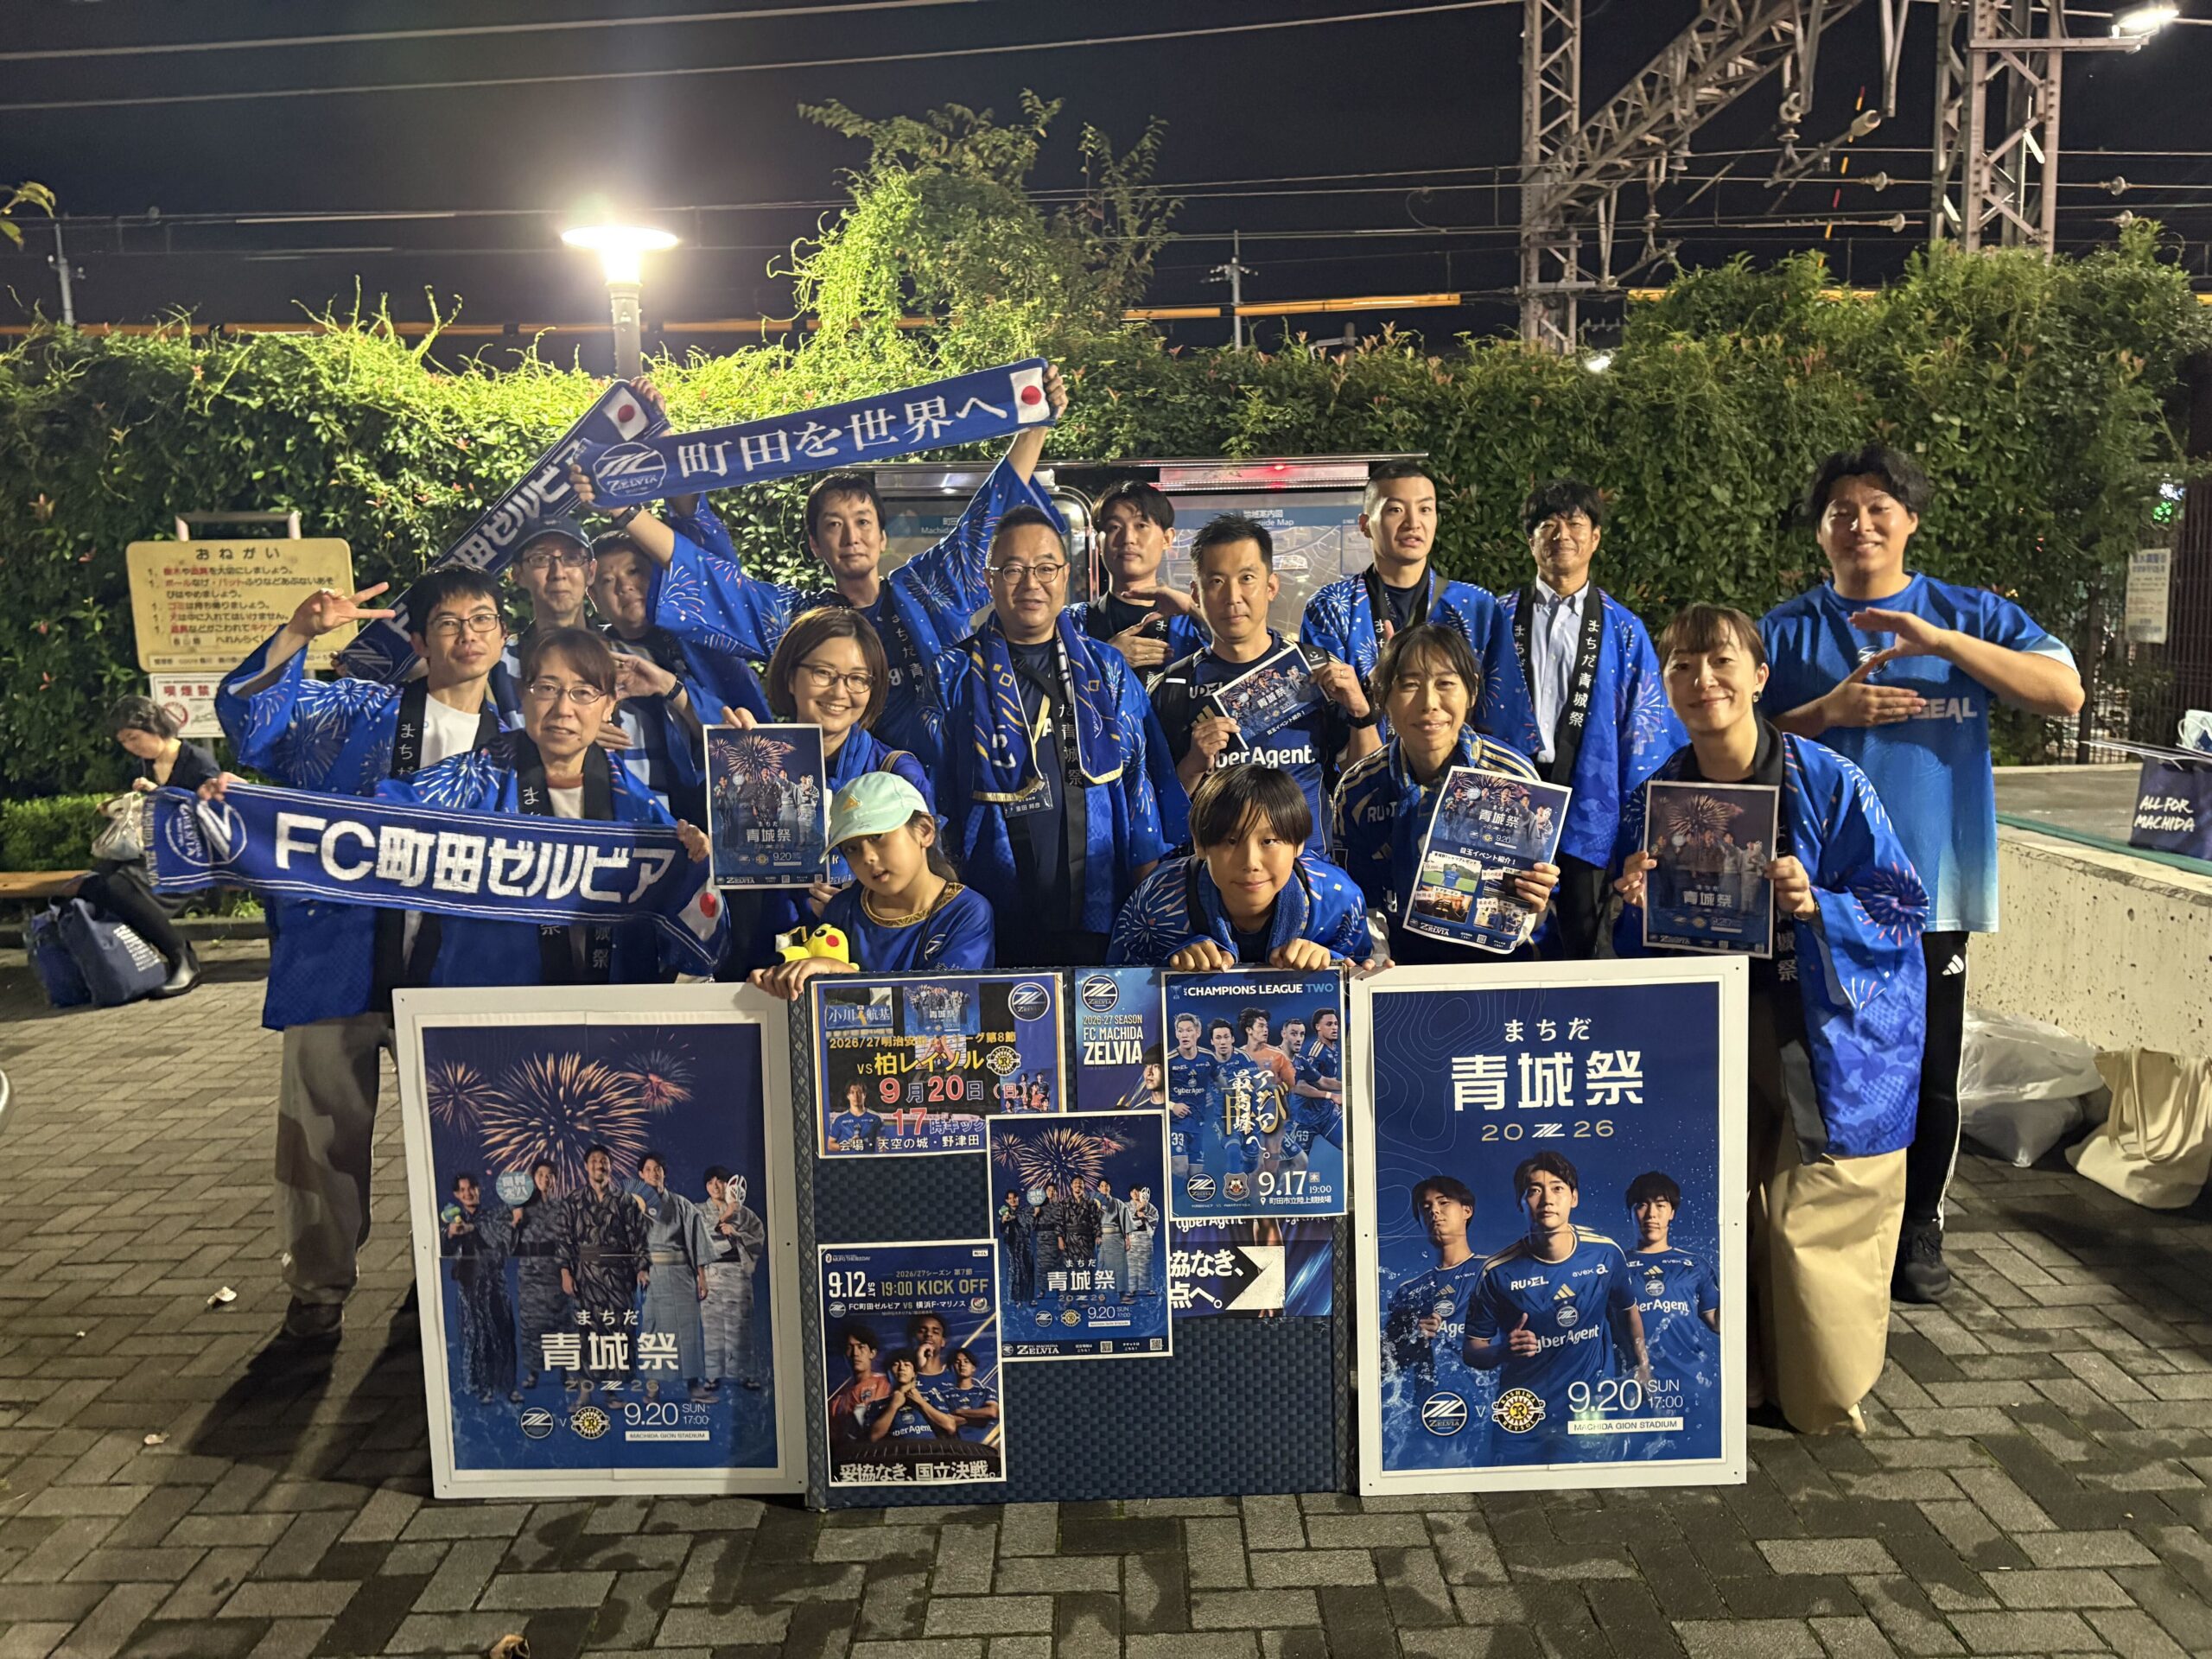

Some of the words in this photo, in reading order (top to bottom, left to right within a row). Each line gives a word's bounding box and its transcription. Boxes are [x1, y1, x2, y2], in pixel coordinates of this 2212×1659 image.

[677, 395, 1008, 479] 町田を世界へ
[1243, 509, 1283, 518] 地域案内図
[195, 547, 280, 561] おねがい
[166, 590, 242, 599] びはやめましょう。
[168, 601, 270, 610] ゴミは持ち帰りましょう。
[1568, 620, 1600, 728] まちだ青城祭
[163, 684, 218, 697] 喫煙禁
[2139, 794, 2160, 810] ALL
[2161, 797, 2194, 814] FOR
[1478, 809, 1520, 830] 青城祭
[2133, 813, 2196, 833] MACHIDA
[746, 828, 792, 843] 青城祭
[1496, 834, 1512, 844] 9.20
[276, 810, 676, 904] FC町田ゼルビア
[772, 851, 792, 862] 9.20
[1459, 846, 1516, 866] 目玉イベント紹介！
[1682, 890, 1732, 908] 青城祭
[1420, 922, 1450, 936] ZELVIA
[1188, 983, 1257, 997] CHAMPIONS
[1259, 983, 1303, 995] LEAGUE
[1306, 982, 1334, 993] TWO
[828, 1009, 855, 1022] 小川
[866, 1007, 892, 1021] 航基
[1083, 1014, 1113, 1026] 2026-27
[1115, 1014, 1143, 1025] SEASON
[1084, 1027, 1096, 1040] FC
[1099, 1026, 1144, 1040] MACHIDA
[1503, 1016, 1592, 1042] まちだ
[1083, 1040, 1143, 1065] ZELVIA
[874, 1049, 985, 1077] 柏レイソル
[879, 1073, 985, 1104] 9月20日
[1451, 1049, 1643, 1112] 青城祭
[1481, 1123, 1524, 1141] 20
[1573, 1119, 1615, 1138] 26
[839, 1134, 981, 1153] 会場・天空の城・野津田
[1257, 1170, 1307, 1197] 9.17
[1310, 1173, 1319, 1182] 木
[1309, 1185, 1332, 1195] 19:00
[1268, 1195, 1332, 1205] 町田市立陸上競技場
[1065, 1258, 1096, 1268] まちだ
[828, 1271, 867, 1299] 9.12
[868, 1281, 876, 1298] SAT
[881, 1281, 913, 1297] 19:00
[917, 1279, 955, 1296] KICK
[958, 1278, 989, 1294] OFF
[1046, 1269, 1116, 1292] 青城祭
[849, 1302, 900, 1311] FC町田ゼルビア
[903, 1301, 913, 1310] VS
[916, 1299, 966, 1309] 横浜F・マリノス
[1087, 1306, 1116, 1319] 9.20
[576, 1308, 639, 1326] まちだ
[540, 1332, 679, 1372] 青城祭
[1017, 1344, 1060, 1355] ZELVIA
[1567, 1379, 1643, 1413] 9.20
[1648, 1379, 1681, 1392] SUN
[1648, 1395, 1684, 1409] 17:00
[624, 1402, 679, 1426] 9.20
[682, 1403, 707, 1414] SUN
[683, 1415, 709, 1425] 17:00
[1573, 1422, 1614, 1432] MACHIDA
[1616, 1421, 1638, 1430] GION
[1639, 1420, 1678, 1430] STADIUM
[839, 1459, 996, 1483] 妥協なき、国立決戦。
